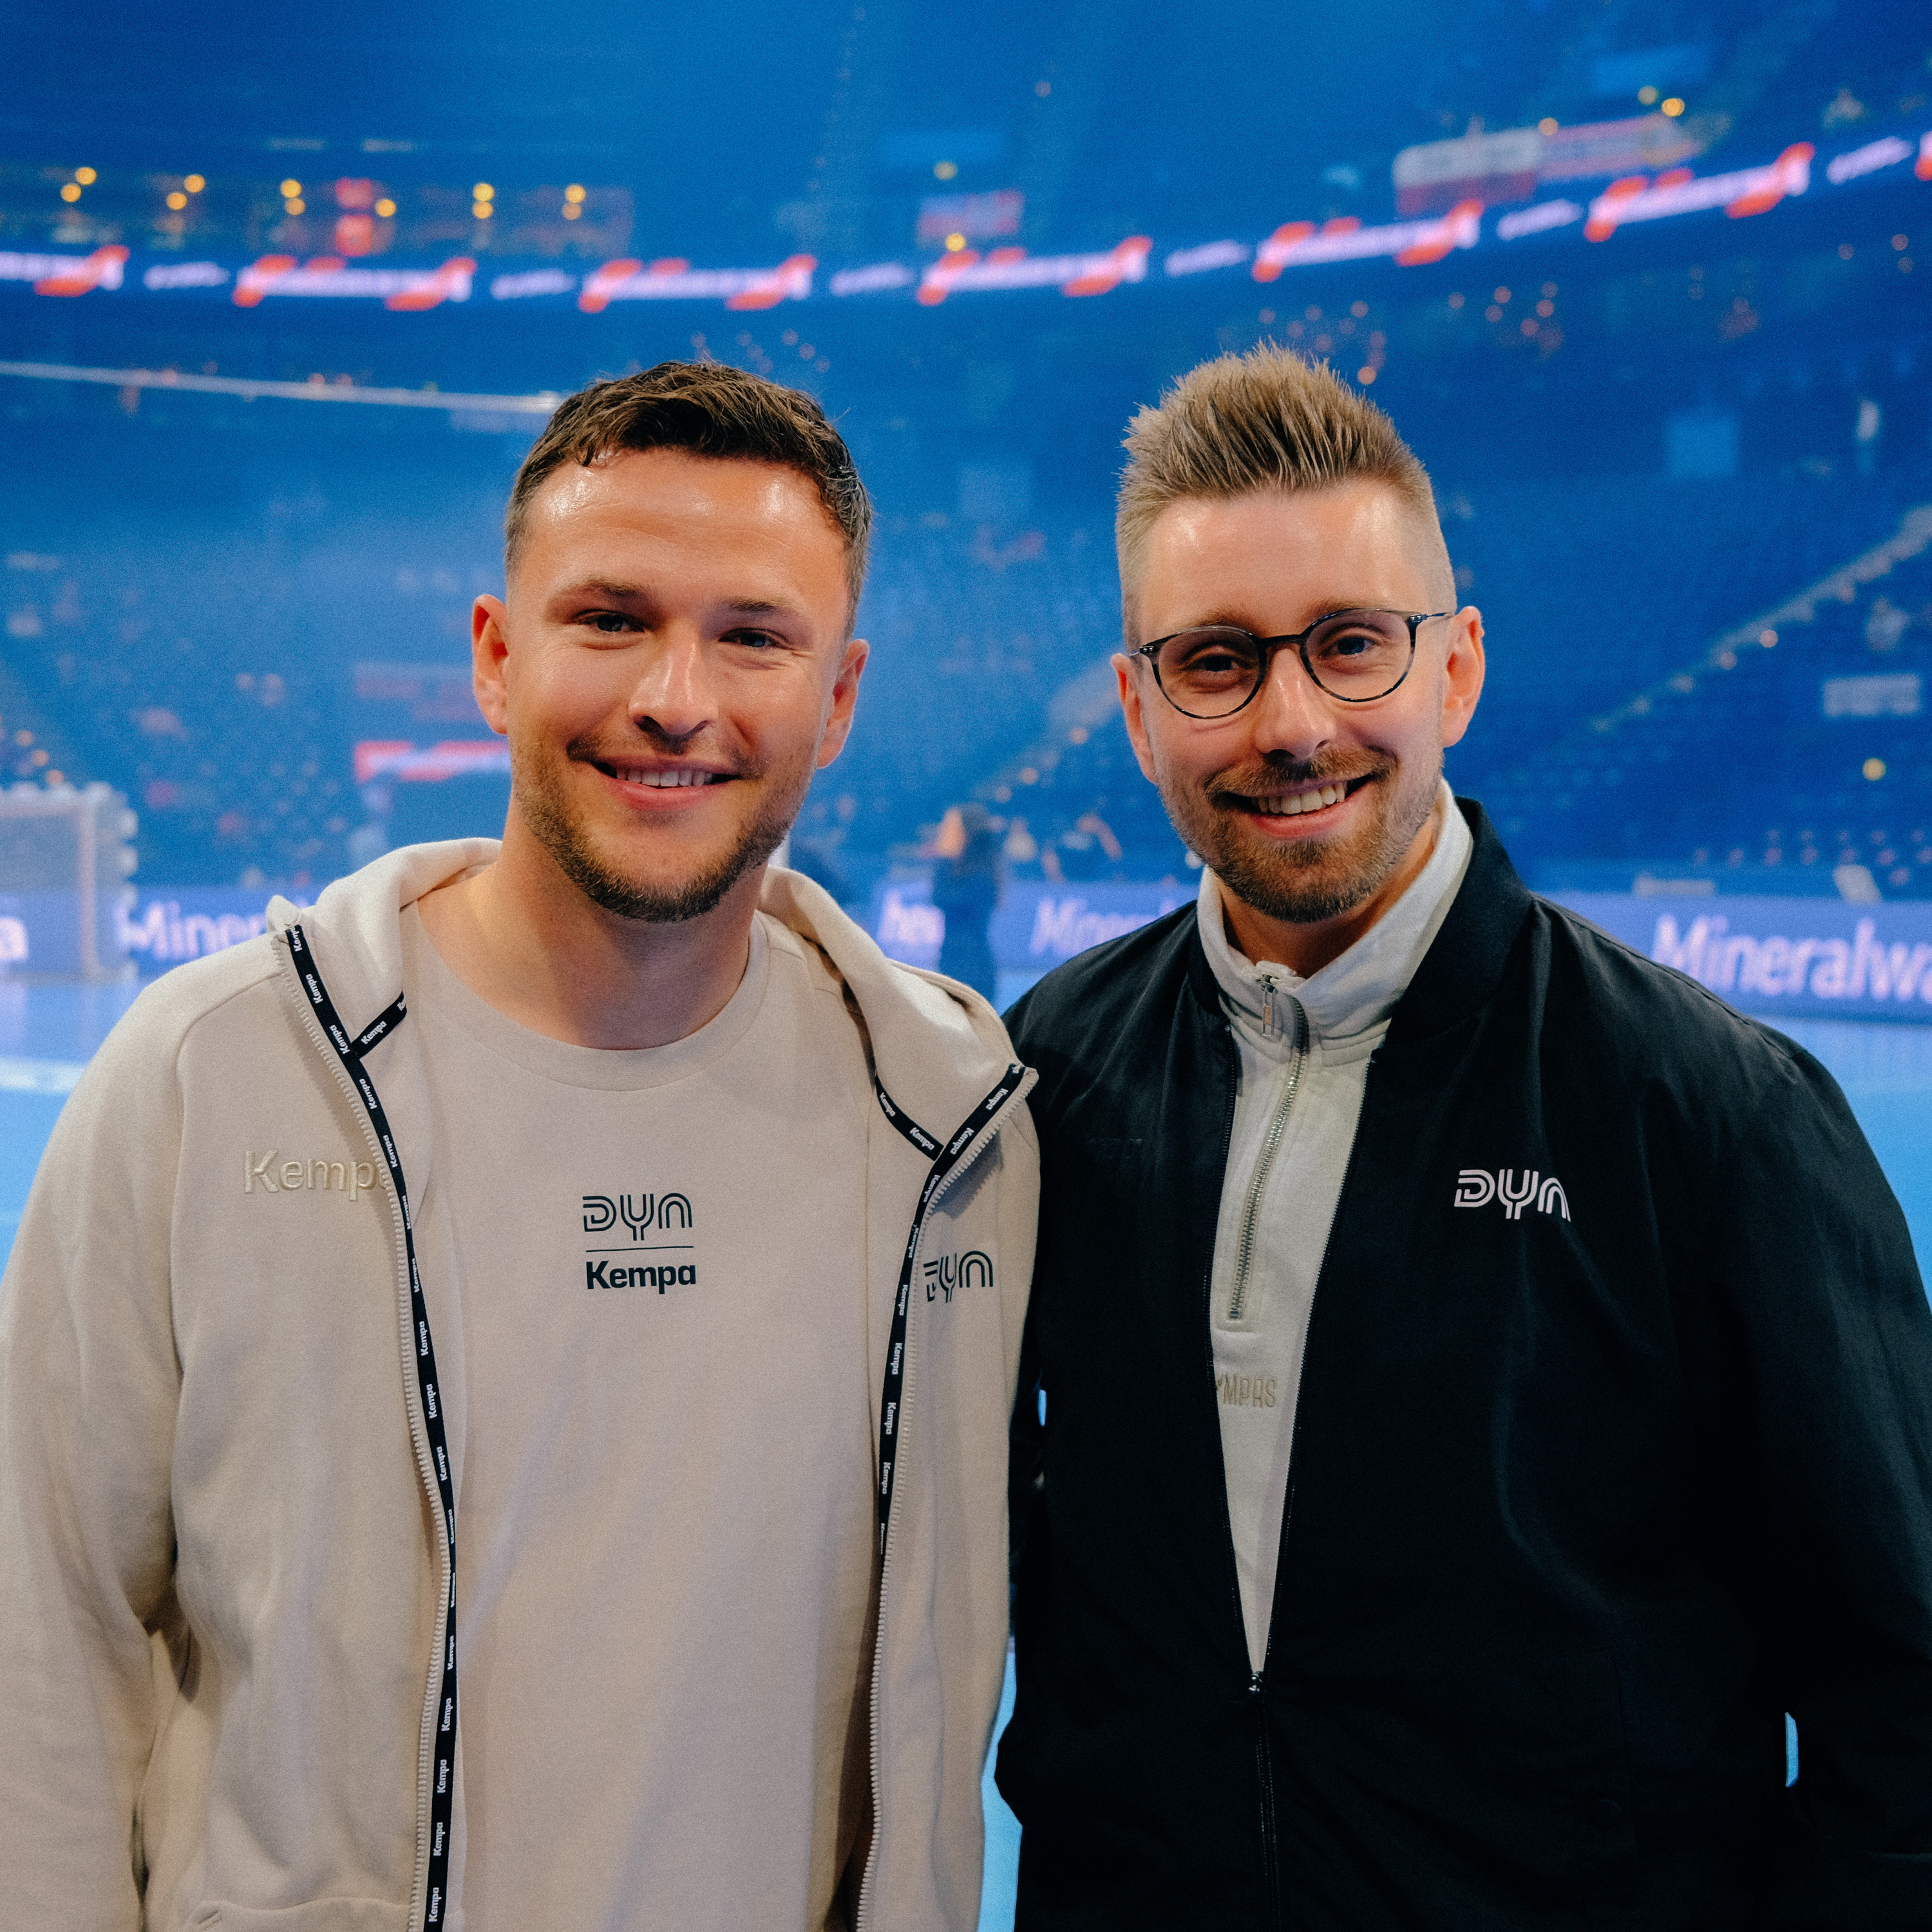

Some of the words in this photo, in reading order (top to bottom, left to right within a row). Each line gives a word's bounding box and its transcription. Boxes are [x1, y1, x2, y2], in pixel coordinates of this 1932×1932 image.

[305, 974, 323, 1004] Kempa
[329, 1025, 350, 1054] Kempa
[361, 1021, 387, 1045] Kempa
[359, 1078, 377, 1110] Kempa
[880, 1092, 896, 1117] Kempa
[985, 1088, 1009, 1110] Kempa
[383, 1135, 398, 1168] Kempa
[909, 1128, 934, 1151] Kempa
[950, 1128, 974, 1155] Kempa
[923, 1174, 941, 1203] Kempa
[586, 1260, 696, 1294] Kempa
[898, 1284, 908, 1316] Kempa
[419, 1321, 429, 1356] Kempa
[890, 1343, 902, 1375] Kempa
[426, 1384, 438, 1419] Kempa
[884, 1402, 896, 1435] Kempa
[437, 1446, 448, 1481] Kempa
[881, 1462, 891, 1495] Kempa
[441, 1698, 453, 1731] Kempa
[437, 1759, 450, 1794] Kempa
[433, 1822, 446, 1856] Kempa
[428, 1887, 442, 1922] Kempa
